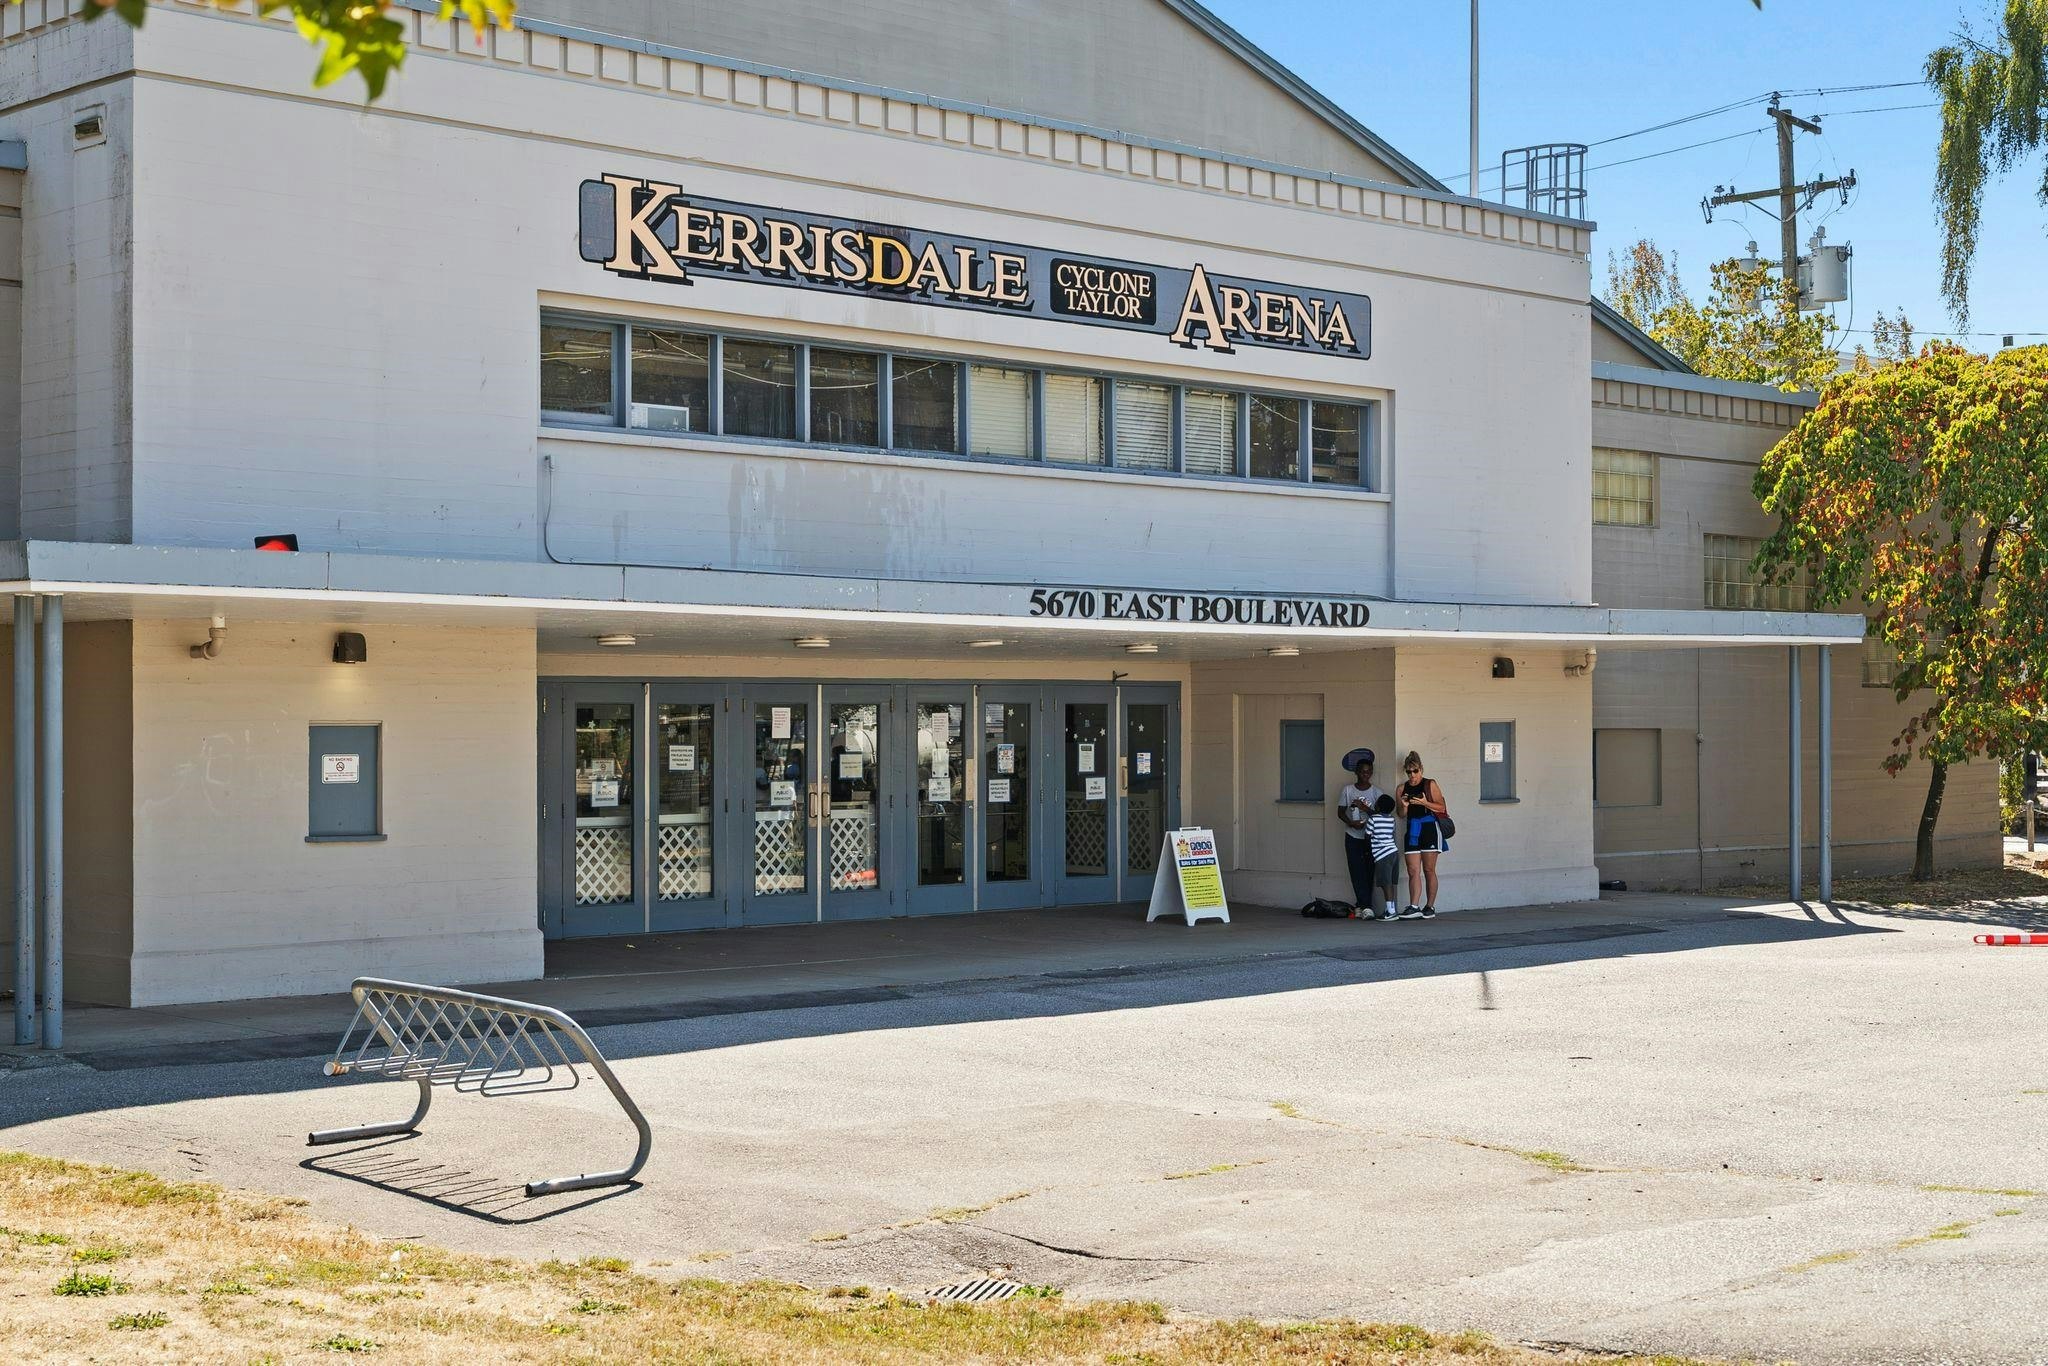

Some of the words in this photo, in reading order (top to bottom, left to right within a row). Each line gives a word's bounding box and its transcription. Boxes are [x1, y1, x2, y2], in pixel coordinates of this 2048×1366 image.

[602, 173, 1032, 306] KERRISDALE
[1169, 263, 1359, 353] ARENA
[1056, 263, 1152, 298] CYCLONE
[1064, 289, 1143, 320] TAYLOR
[1029, 588, 1096, 619] 5670
[1102, 591, 1186, 621] EAST
[1190, 596, 1371, 628] BOULEVARD
